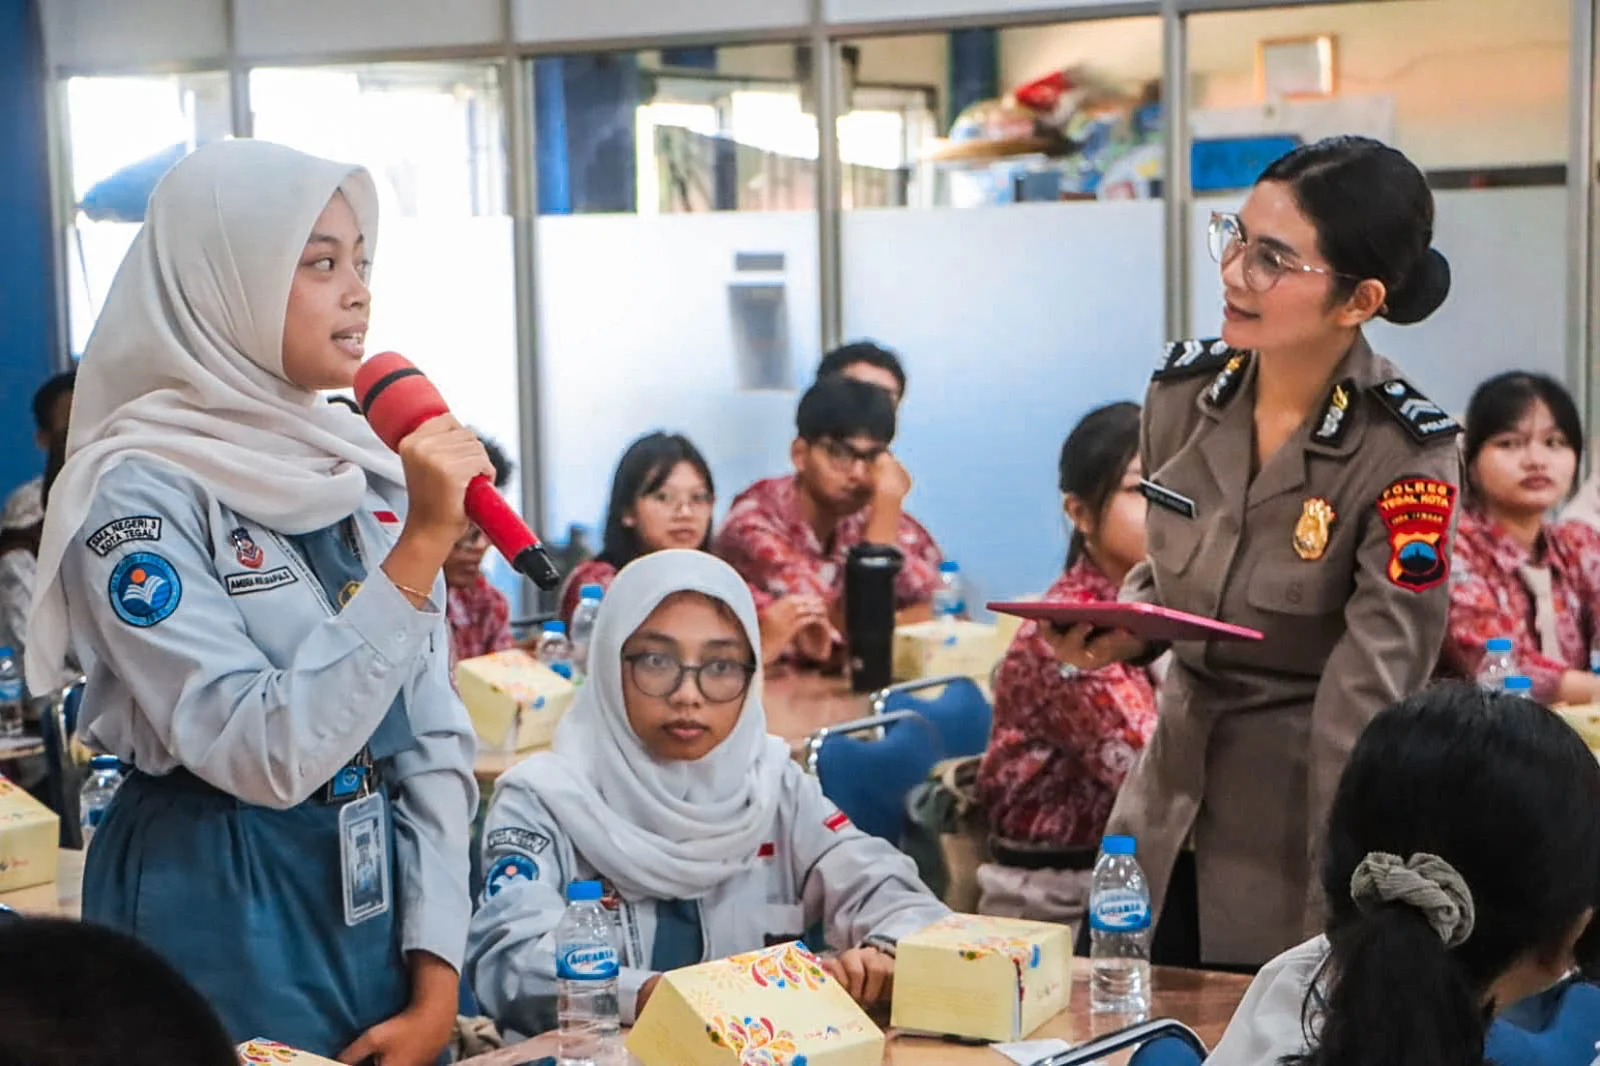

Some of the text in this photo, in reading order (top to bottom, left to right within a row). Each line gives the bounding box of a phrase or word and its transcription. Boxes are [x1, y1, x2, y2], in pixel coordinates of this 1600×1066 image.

[1383, 481, 1448, 499] POLRES
[1420, 494, 1449, 508] KOTA
[92, 529, 111, 547] SMA
[111, 519, 148, 533] NEGERI
[100, 527, 155, 551] KOTA TEGAL
